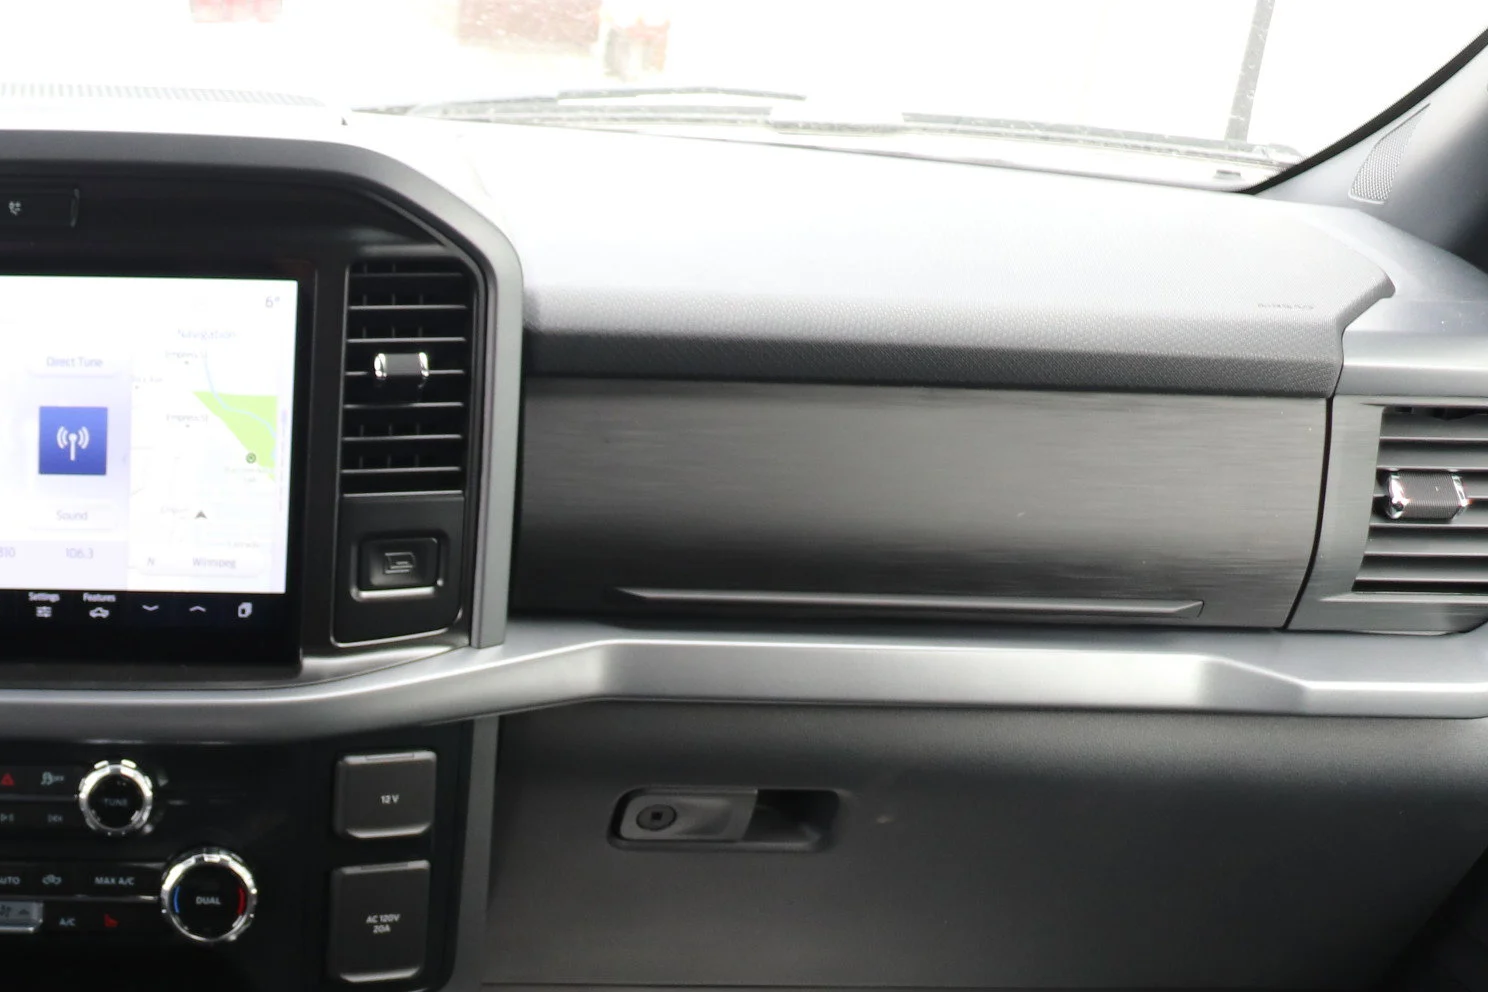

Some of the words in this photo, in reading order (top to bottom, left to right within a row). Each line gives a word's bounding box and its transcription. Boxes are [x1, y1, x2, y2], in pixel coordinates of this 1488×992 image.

[46, 356, 76, 368] Direct
[78, 356, 104, 368] Tune
[55, 509, 89, 521] Sound
[192, 557, 237, 569] Winnipeg
[27, 592, 61, 603] Settings
[82, 592, 117, 603] Features
[104, 798, 128, 807] TUNE
[380, 795, 392, 804] 12
[94, 876, 117, 886] MAX
[118, 876, 136, 886] A/C
[195, 896, 222, 906] DUAL
[58, 917, 77, 927] A/C
[366, 914, 378, 924] AC
[380, 913, 401, 923] 120V
[372, 925, 392, 934] 20A
